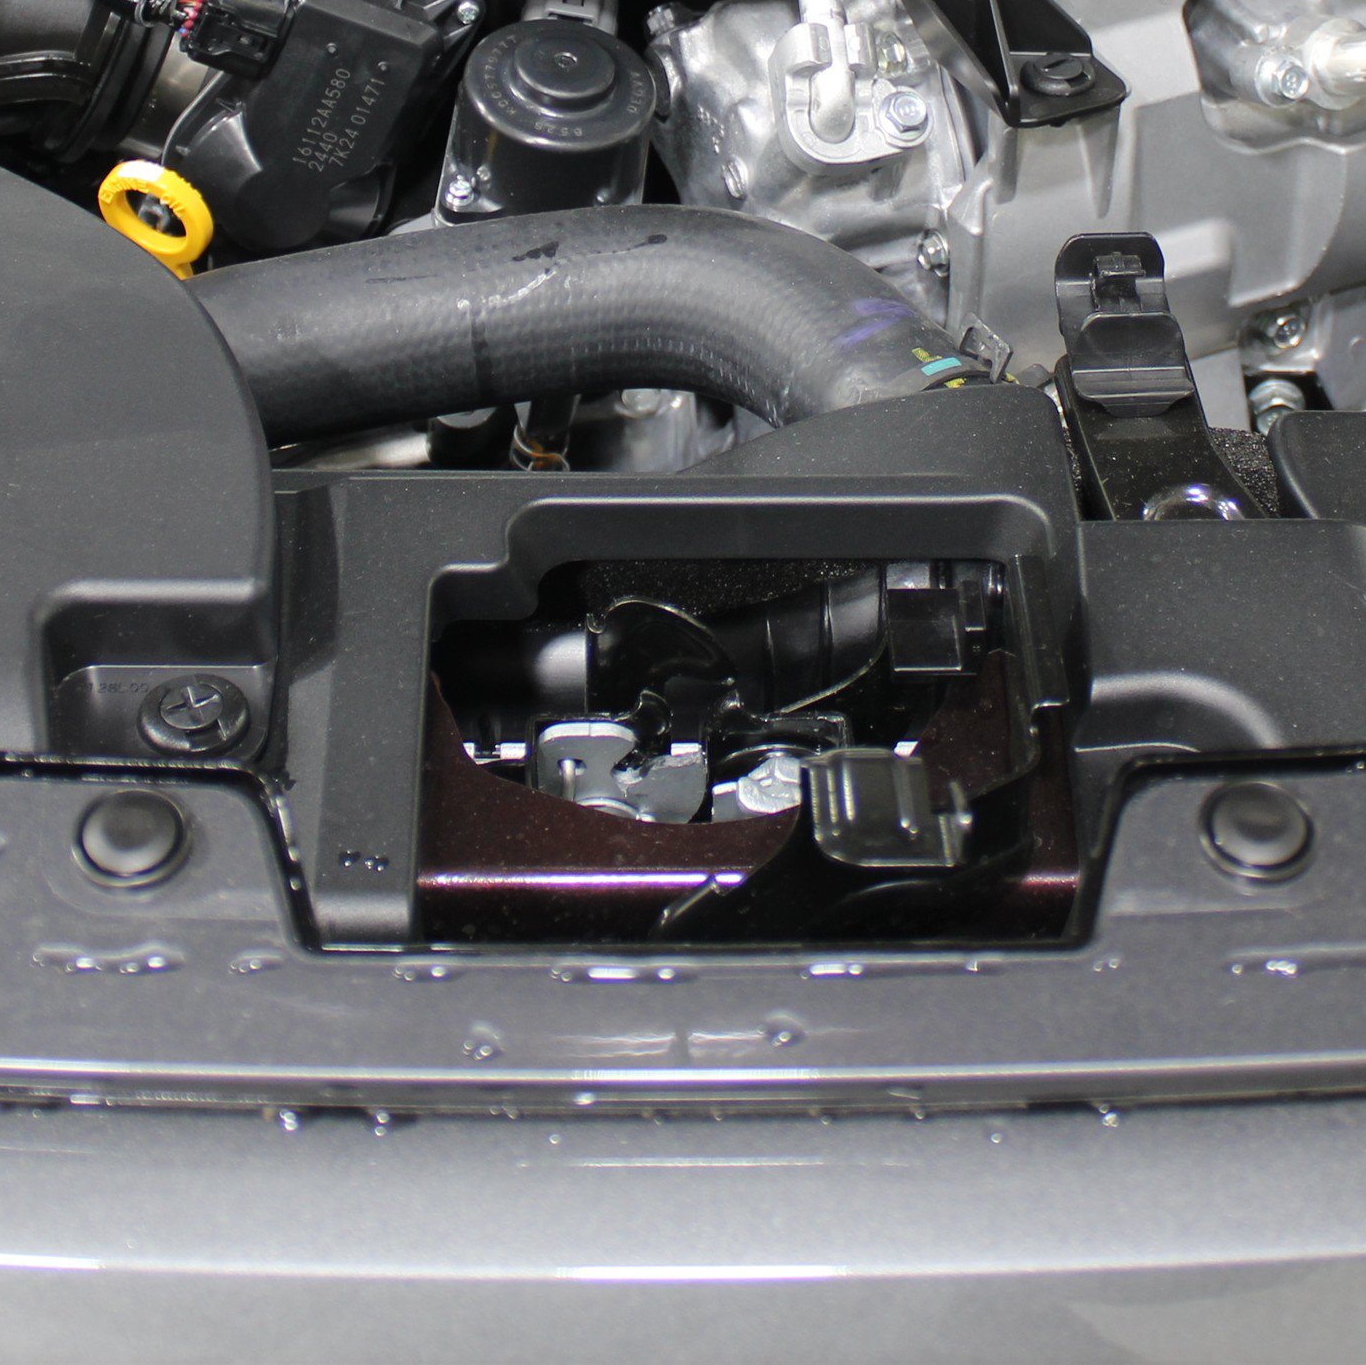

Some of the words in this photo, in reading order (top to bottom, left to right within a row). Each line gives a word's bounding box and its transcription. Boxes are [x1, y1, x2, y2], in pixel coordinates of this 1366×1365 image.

[292, 67, 351, 165] 16112AA580
[328, 128, 360, 167] 7K24
[350, 78, 385, 125] 01471
[308, 132, 338, 172] 2440
[159, 193, 186, 220] OIL
